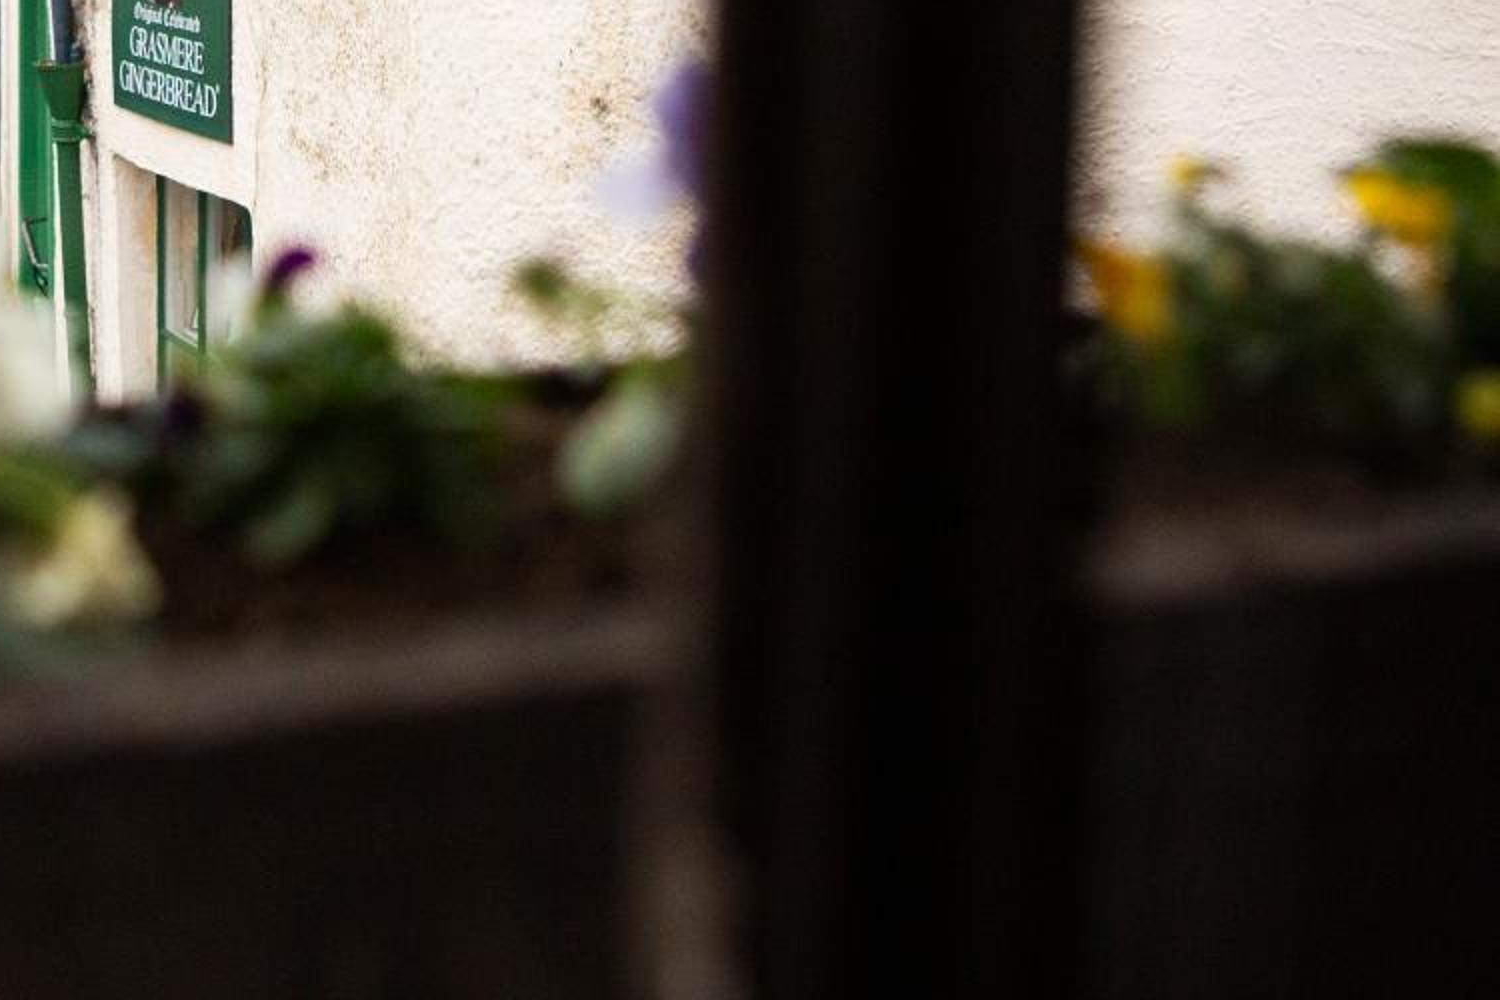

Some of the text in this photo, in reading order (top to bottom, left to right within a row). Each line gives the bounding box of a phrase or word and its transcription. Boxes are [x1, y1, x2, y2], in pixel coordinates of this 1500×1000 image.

[133, 1, 201, 34] Original Celebrated
[129, 25, 204, 75] GRASMERE
